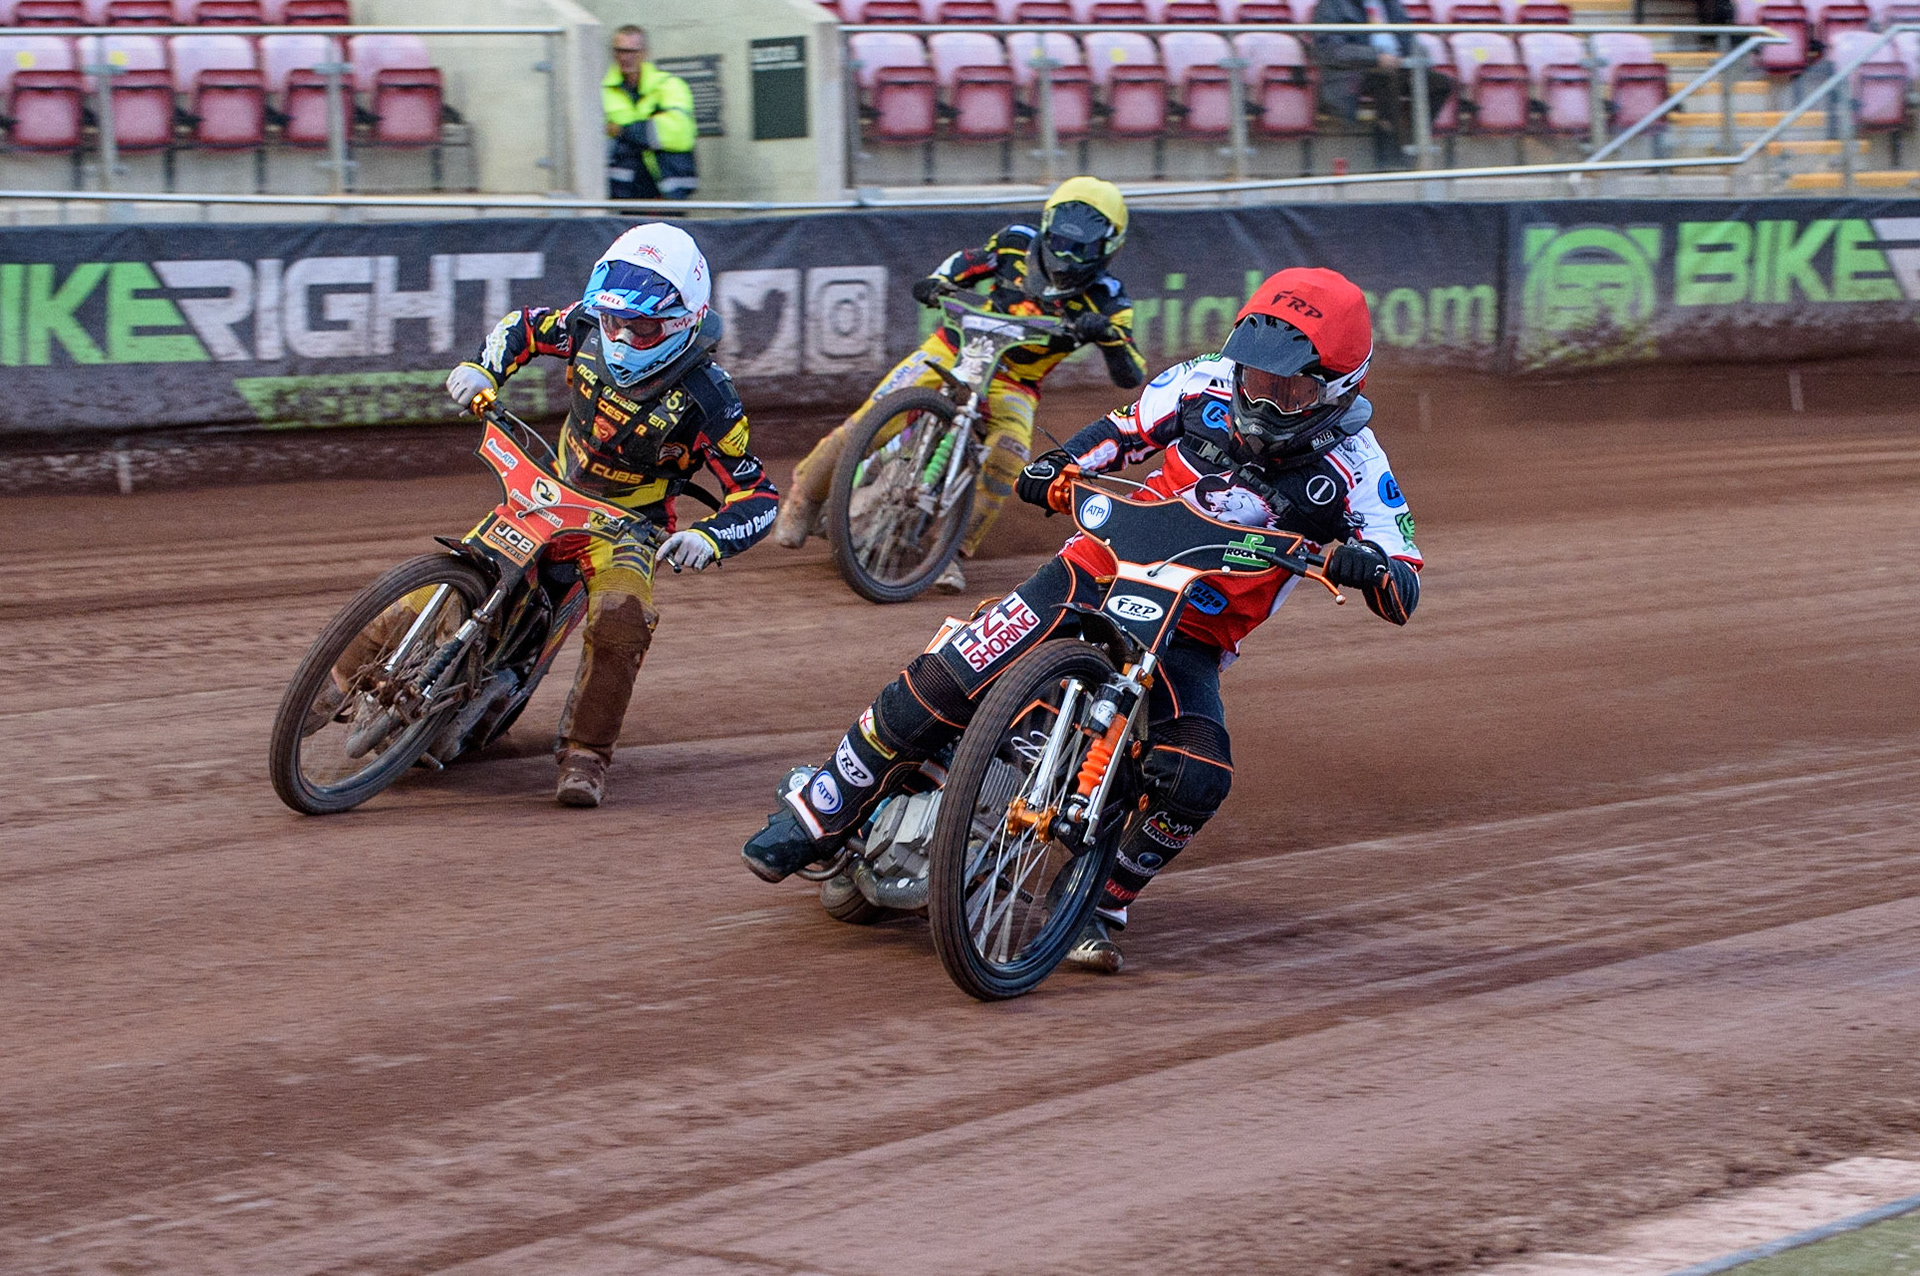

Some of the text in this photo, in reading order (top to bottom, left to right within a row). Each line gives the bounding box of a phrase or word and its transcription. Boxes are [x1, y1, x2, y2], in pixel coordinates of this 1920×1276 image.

[600, 294, 622, 306] BELL
[1271, 290, 1323, 319] FRP
[591, 462, 644, 484] CUBS
[1086, 504, 1105, 518] ATPI
[494, 522, 535, 554] JCB
[1117, 597, 1157, 615] FRP
[969, 609, 1039, 670] SHORING
[839, 739, 868, 780] FRP
[816, 781, 835, 805] ATPI
